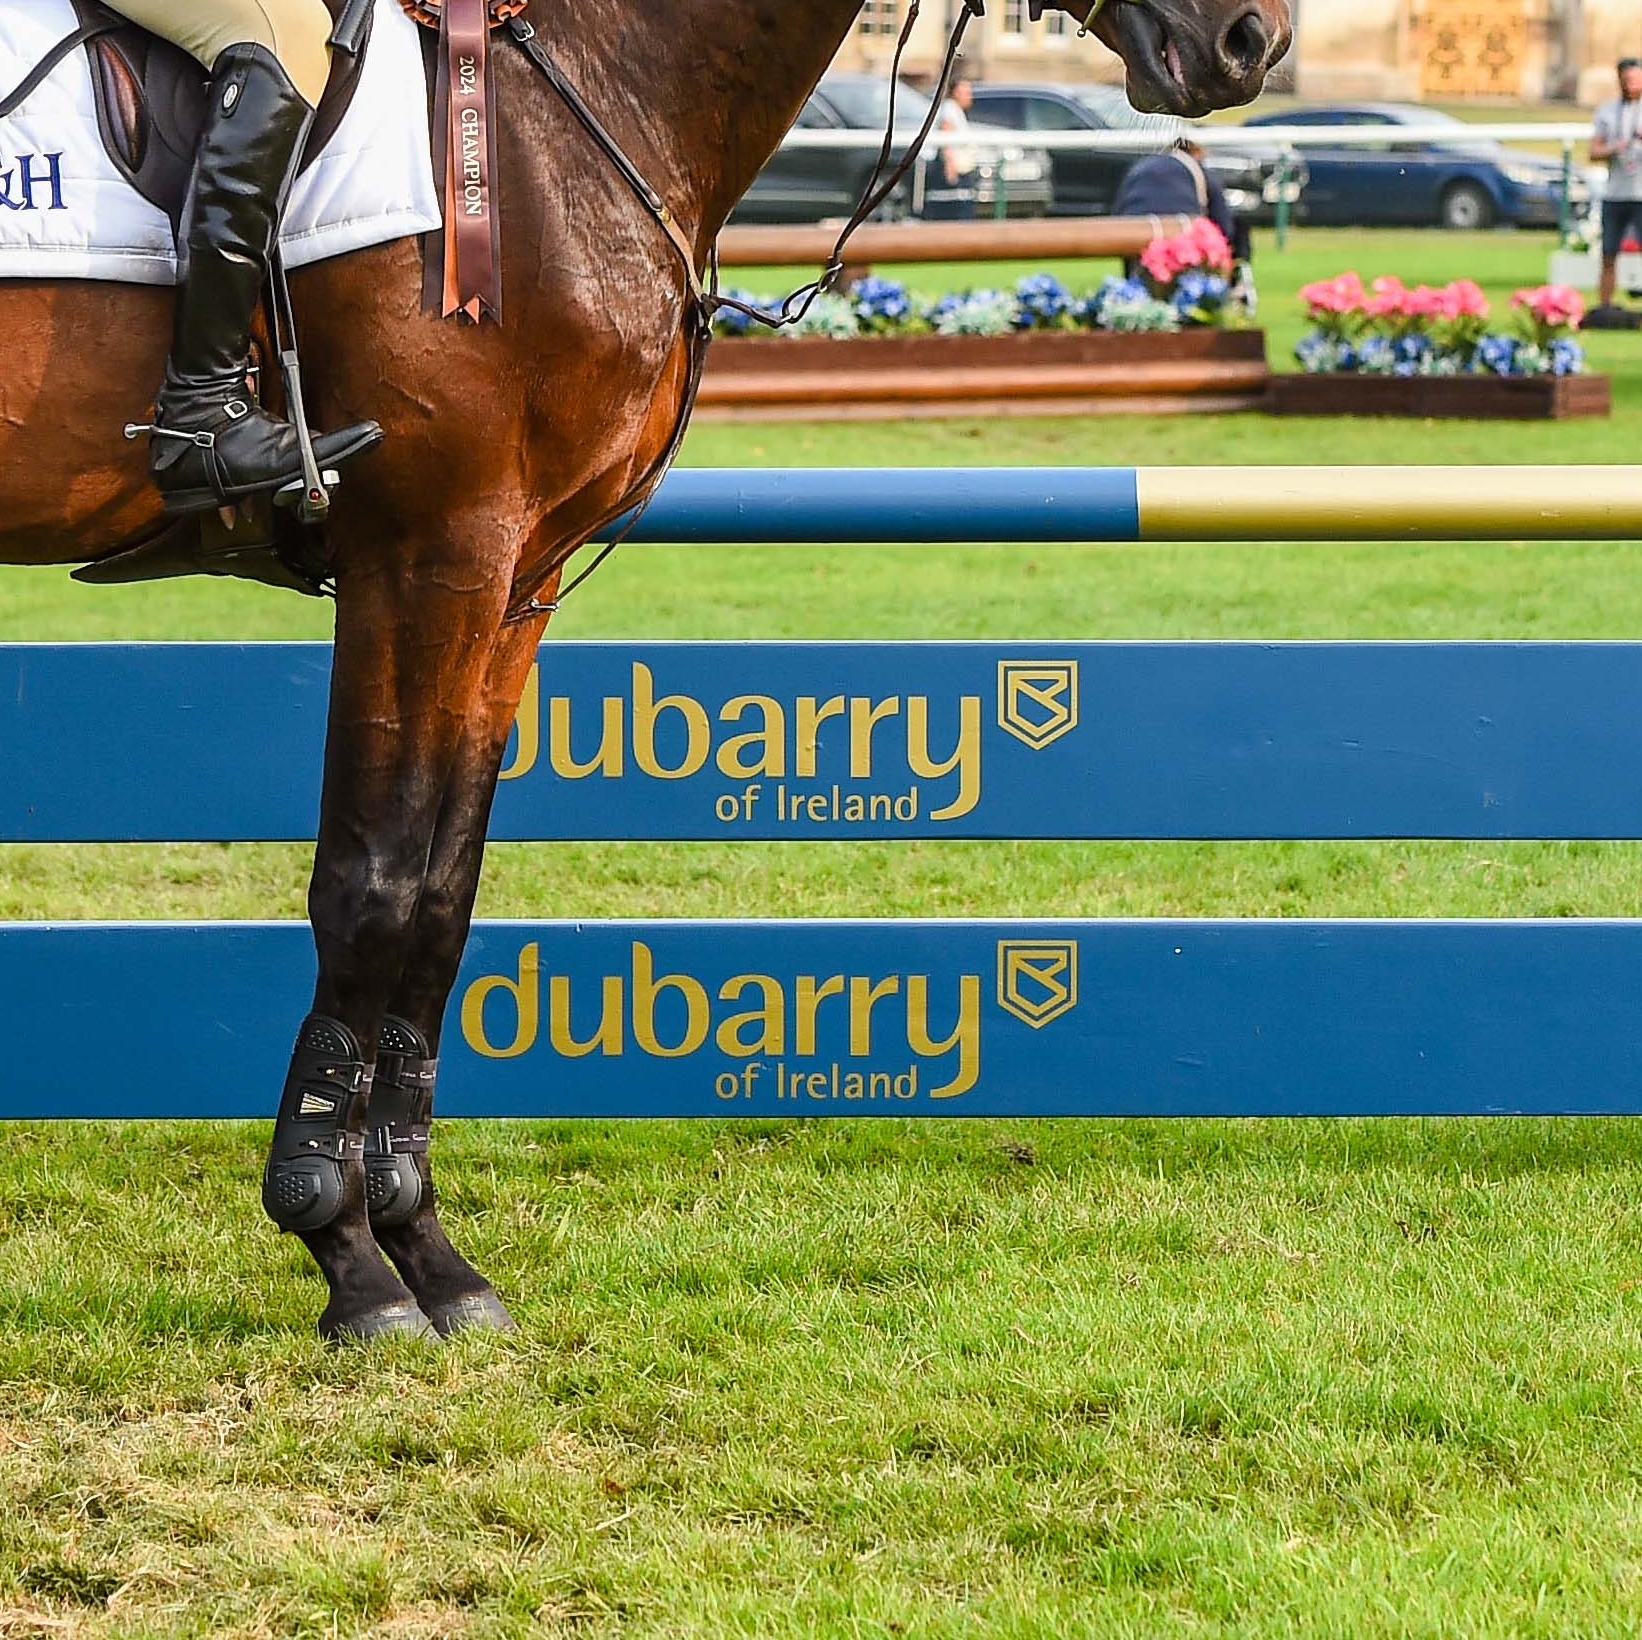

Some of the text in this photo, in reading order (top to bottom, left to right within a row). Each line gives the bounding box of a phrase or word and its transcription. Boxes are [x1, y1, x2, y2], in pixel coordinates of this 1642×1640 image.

[459, 55, 483, 215] 2024 CHAMPION
[715, 784, 918, 821] of Ireland
[460, 941, 981, 1099] dubarry
[715, 1063, 918, 1100] of Ireland
